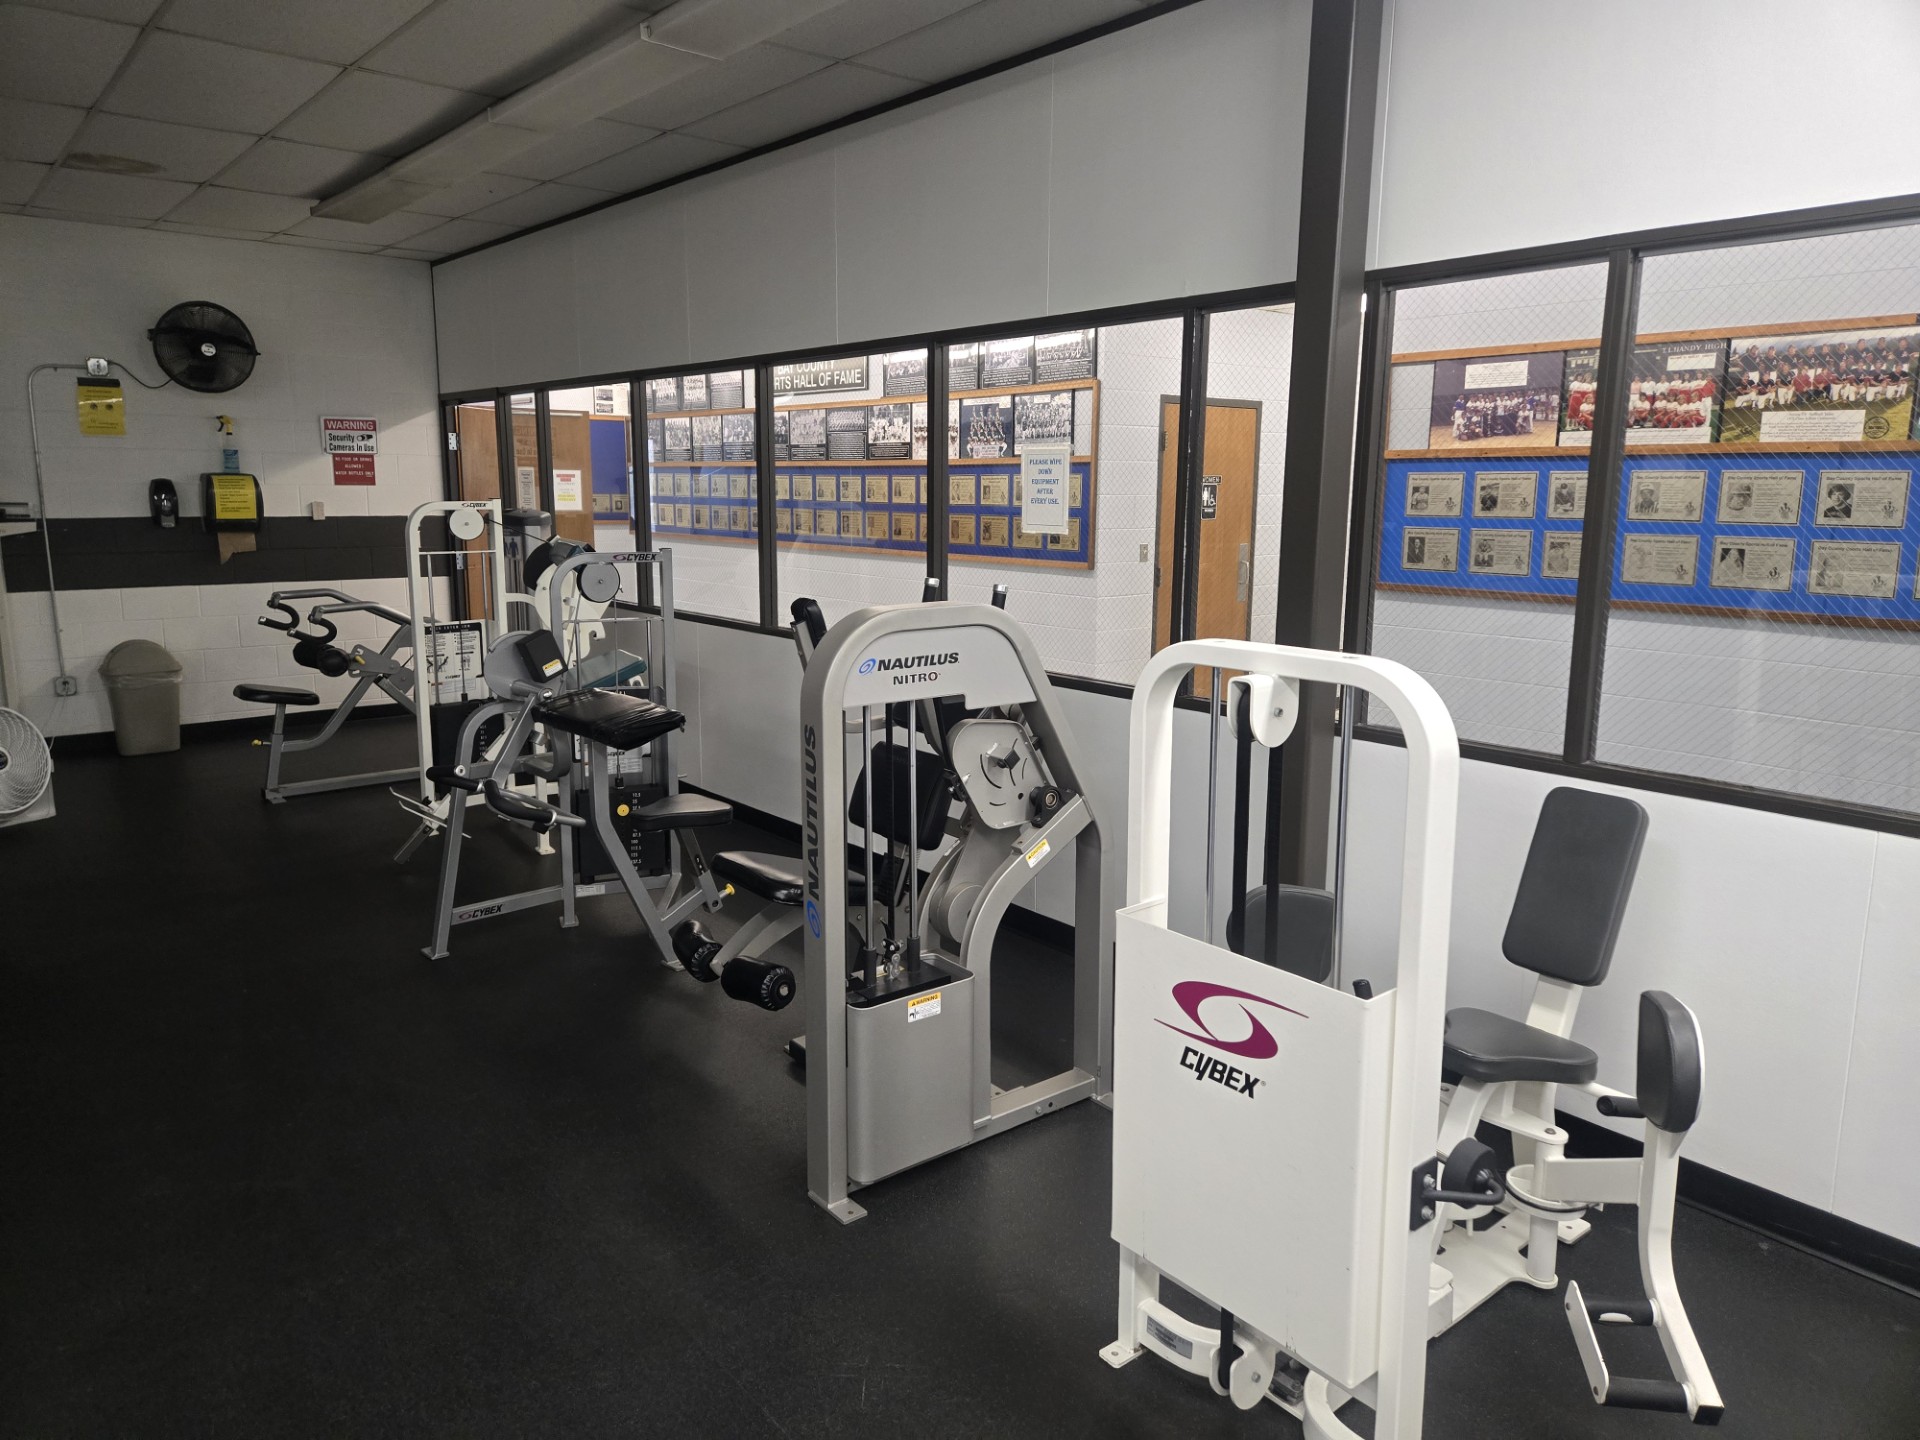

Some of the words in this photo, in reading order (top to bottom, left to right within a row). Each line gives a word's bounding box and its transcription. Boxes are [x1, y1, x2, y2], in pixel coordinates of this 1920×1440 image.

[778, 364, 794, 374] BAY
[797, 360, 835, 372] COUNTY
[774, 376, 792, 390] RTS
[794, 374, 817, 388] HALL
[818, 372, 832, 386] OF
[834, 368, 862, 385] FAME
[326, 420, 374, 430] WARNING
[328, 432, 354, 443] Security
[329, 443, 355, 451] Cameras
[877, 652, 959, 672] NAUTILUS
[893, 672, 938, 685] NITRO
[804, 724, 819, 900] NAUTILUS
[472, 904, 503, 918] CYBEX
[916, 994, 938, 1004] WARNING
[1180, 1046, 1260, 1099] CYBEX
